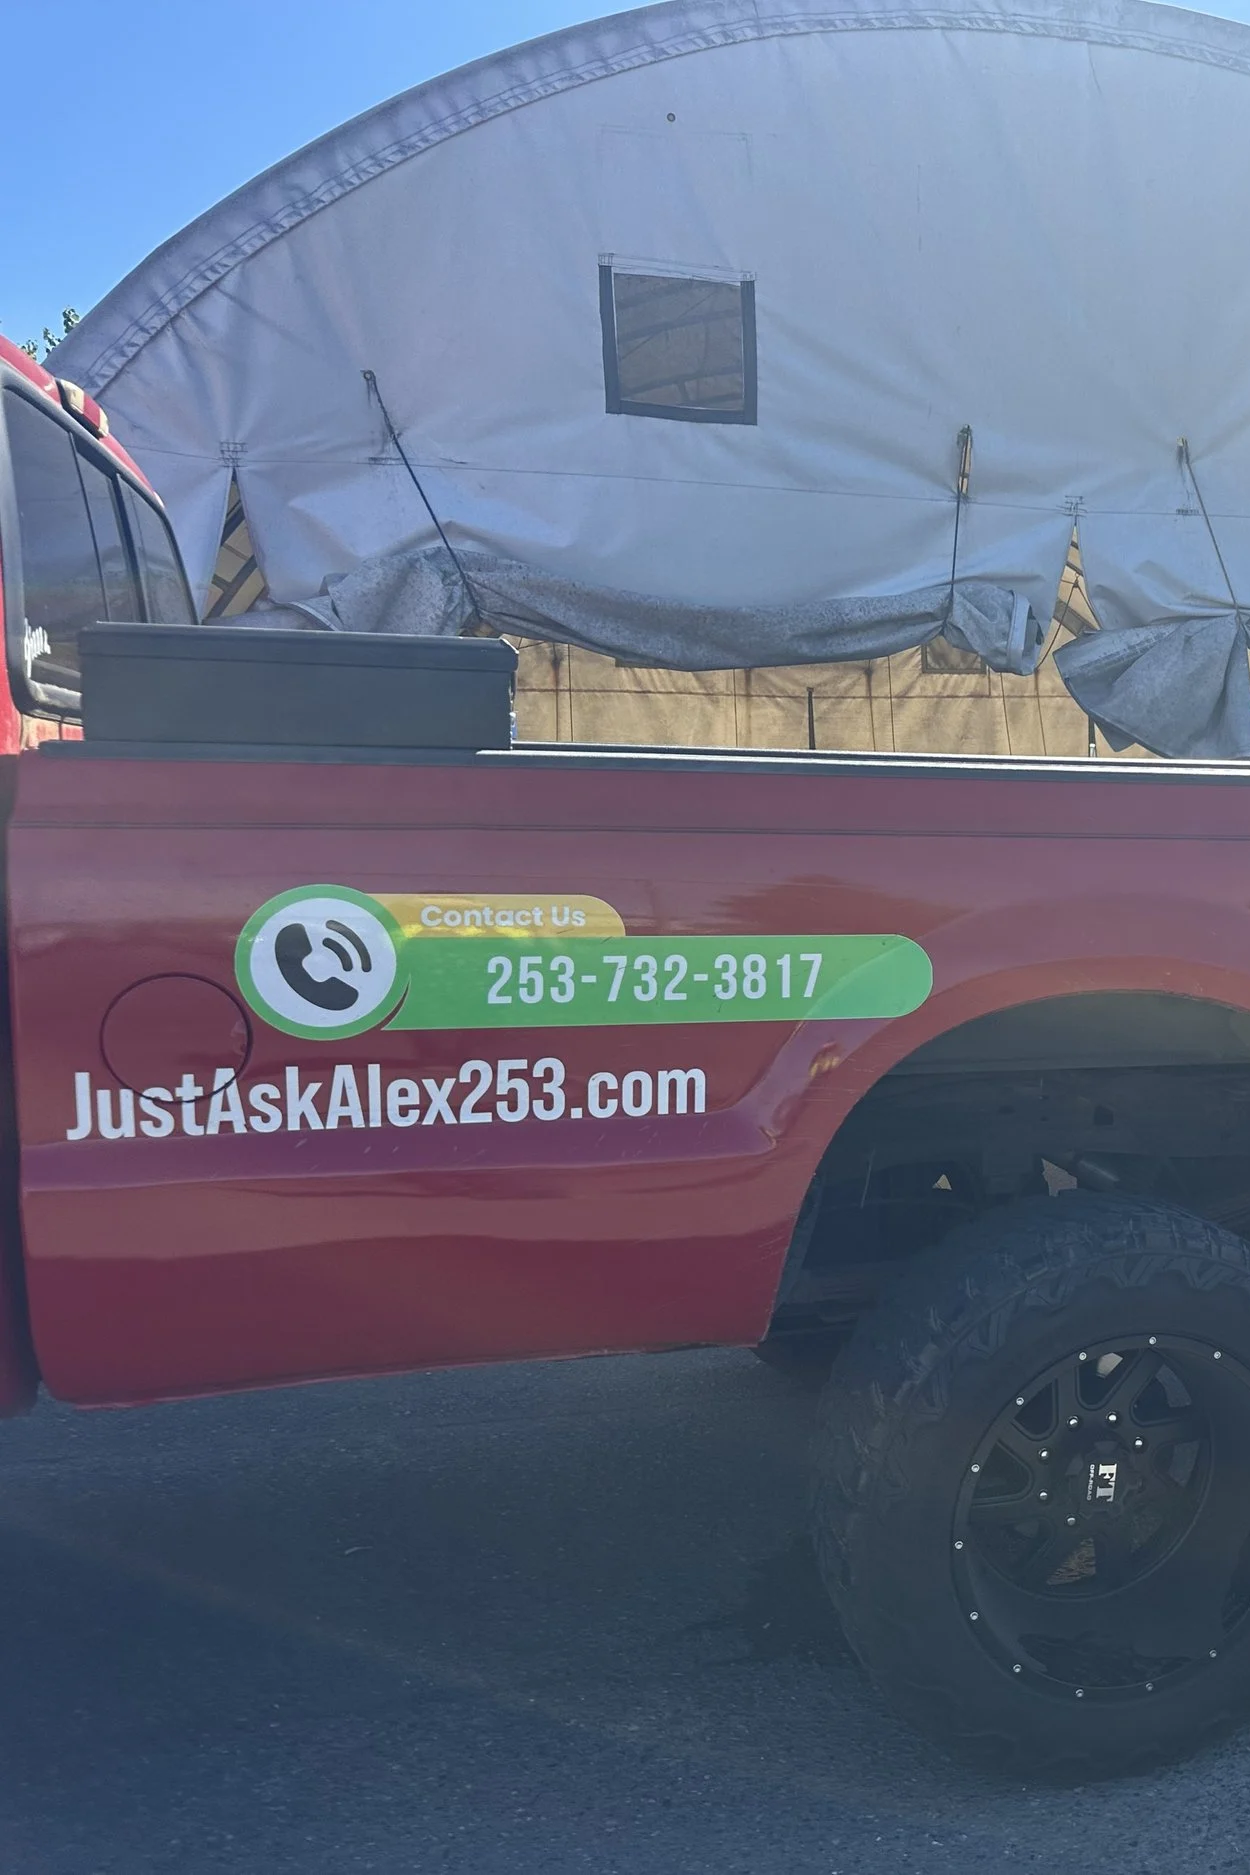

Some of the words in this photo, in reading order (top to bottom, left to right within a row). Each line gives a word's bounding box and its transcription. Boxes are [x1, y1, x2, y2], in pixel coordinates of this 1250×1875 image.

[420, 905, 543, 927] Contact
[551, 906, 587, 927] Us
[487, 953, 823, 1004] 253-732-3817
[66, 1057, 707, 1141] JustAskAlex253.com
